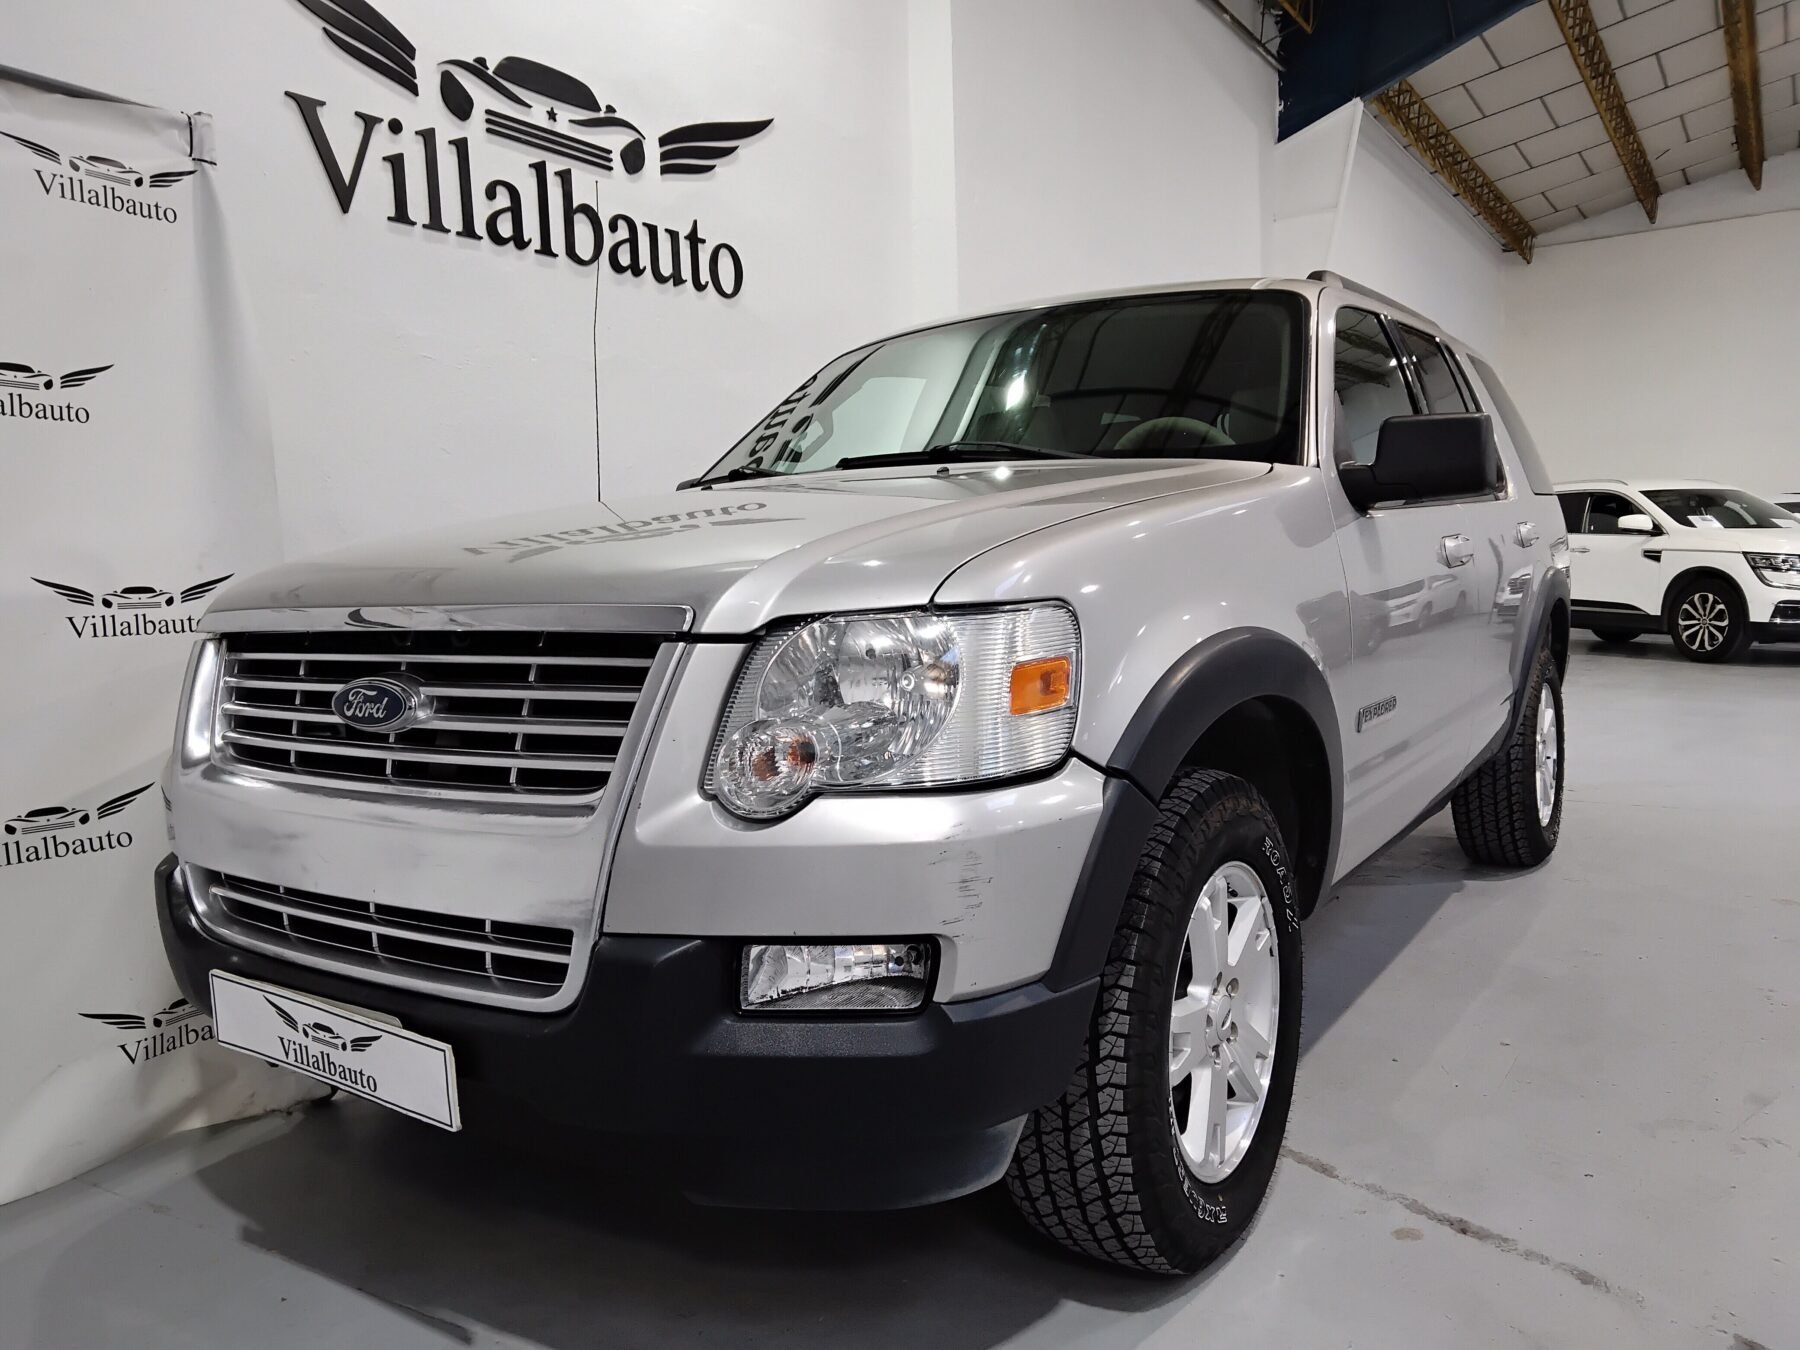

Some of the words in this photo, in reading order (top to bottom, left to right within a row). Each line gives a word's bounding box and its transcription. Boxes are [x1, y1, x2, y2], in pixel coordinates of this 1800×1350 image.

[33, 168, 178, 224] Villalbauto
[284, 91, 744, 299] Villalbauto
[65, 613, 201, 639] Villalbaut
[343, 688, 389, 719] Ford
[1362, 697, 1397, 723] EXPLORER
[0, 829, 133, 868] llalbauto
[277, 1035, 378, 1094] Villalbauto
